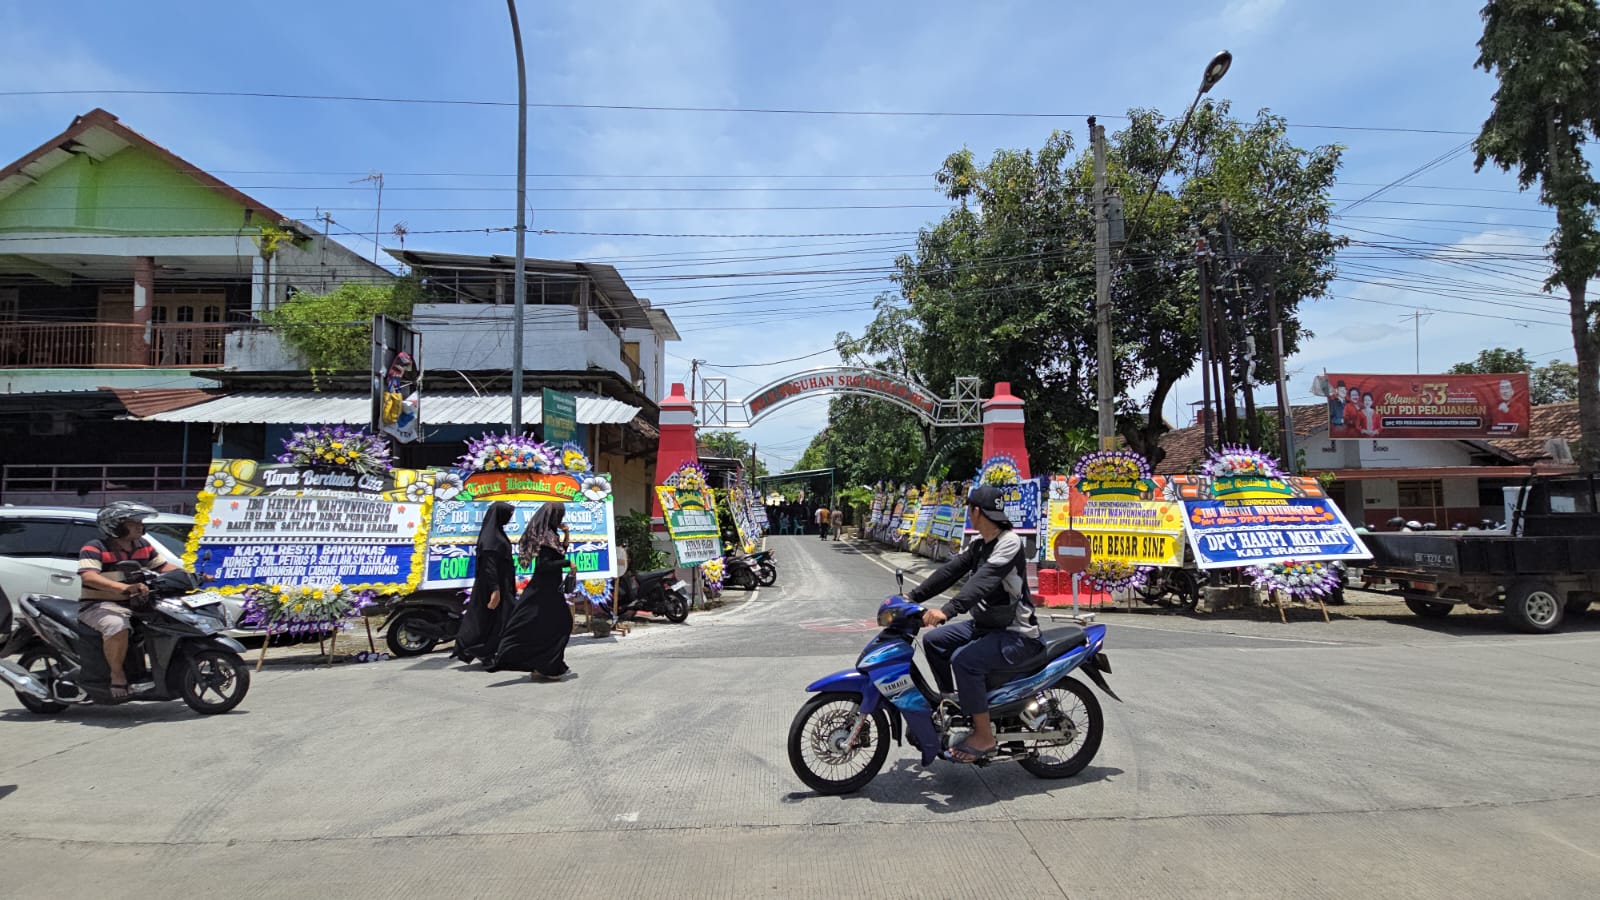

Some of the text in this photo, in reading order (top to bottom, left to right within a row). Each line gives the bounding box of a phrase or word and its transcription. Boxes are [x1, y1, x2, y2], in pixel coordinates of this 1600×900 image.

[1420, 383, 1448, 405] 53
[1376, 405, 1486, 416] HUT PDI PERJUANGAN
[263, 469, 384, 491] Turut Berduka Cita
[467, 481, 501, 496] Turut
[505, 477, 551, 492] Berduka
[247, 499, 393, 515] IBU HERTATI WAHYUNINGSIH
[1108, 508, 1157, 517] WAHYUNINGSIH
[244, 511, 261, 521] IBU
[265, 512, 287, 521] DARI
[289, 512, 316, 521] AIPTU
[345, 513, 390, 523] PURWANTO
[451, 511, 470, 524] IBU
[280, 522, 330, 531] SATLANTAS
[332, 522, 364, 532] POLRES
[366, 523, 398, 533] SRAGEN
[1107, 535, 1138, 557] BESAR
[1142, 537, 1166, 558] SINE
[1206, 529, 1350, 551] DPC HARPI MELATI
[234, 545, 386, 557] KAPOLRESTA BANYUMAS
[1271, 546, 1322, 557] SRAGEN
[222, 556, 259, 568] KOMBES
[439, 557, 470, 580] GOW
[224, 567, 252, 578] KETUA
[254, 566, 307, 577] BHAYANGKARI
[308, 566, 337, 576] CABANG
[338, 566, 357, 576] KOTA
[359, 565, 399, 576] BANYUMAS
[301, 575, 342, 585] PETRUS
[884, 679, 907, 692] YAMAHA
